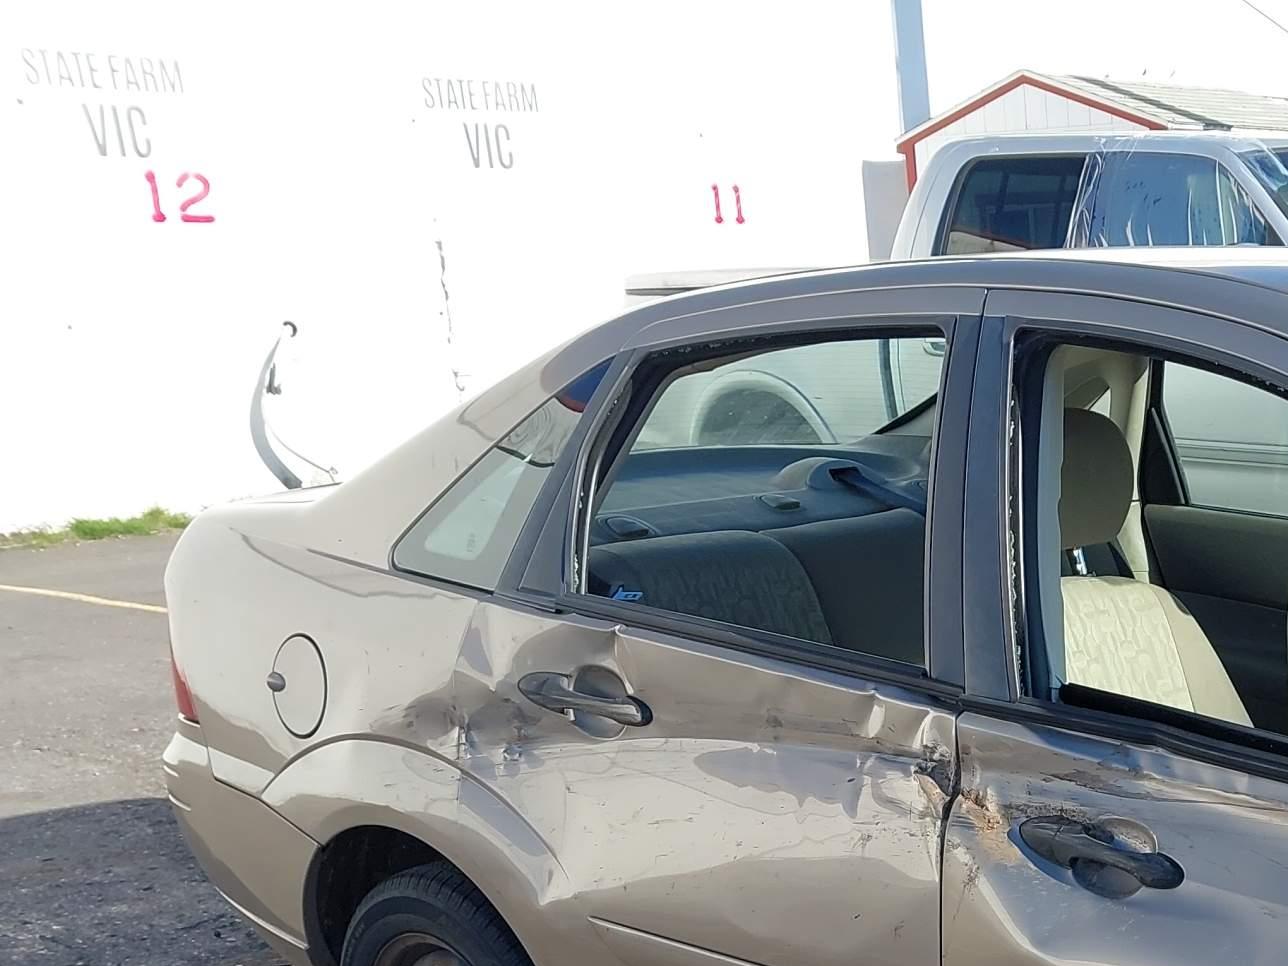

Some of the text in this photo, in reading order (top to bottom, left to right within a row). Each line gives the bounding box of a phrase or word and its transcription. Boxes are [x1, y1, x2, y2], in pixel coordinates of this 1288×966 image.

[20, 47, 184, 94] STATE FARM
[421, 77, 540, 113] STATE FARM
[82, 103, 152, 159] VIC
[462, 121, 515, 170] VIC
[143, 169, 216, 224] 12
[710, 183, 746, 226] 11
